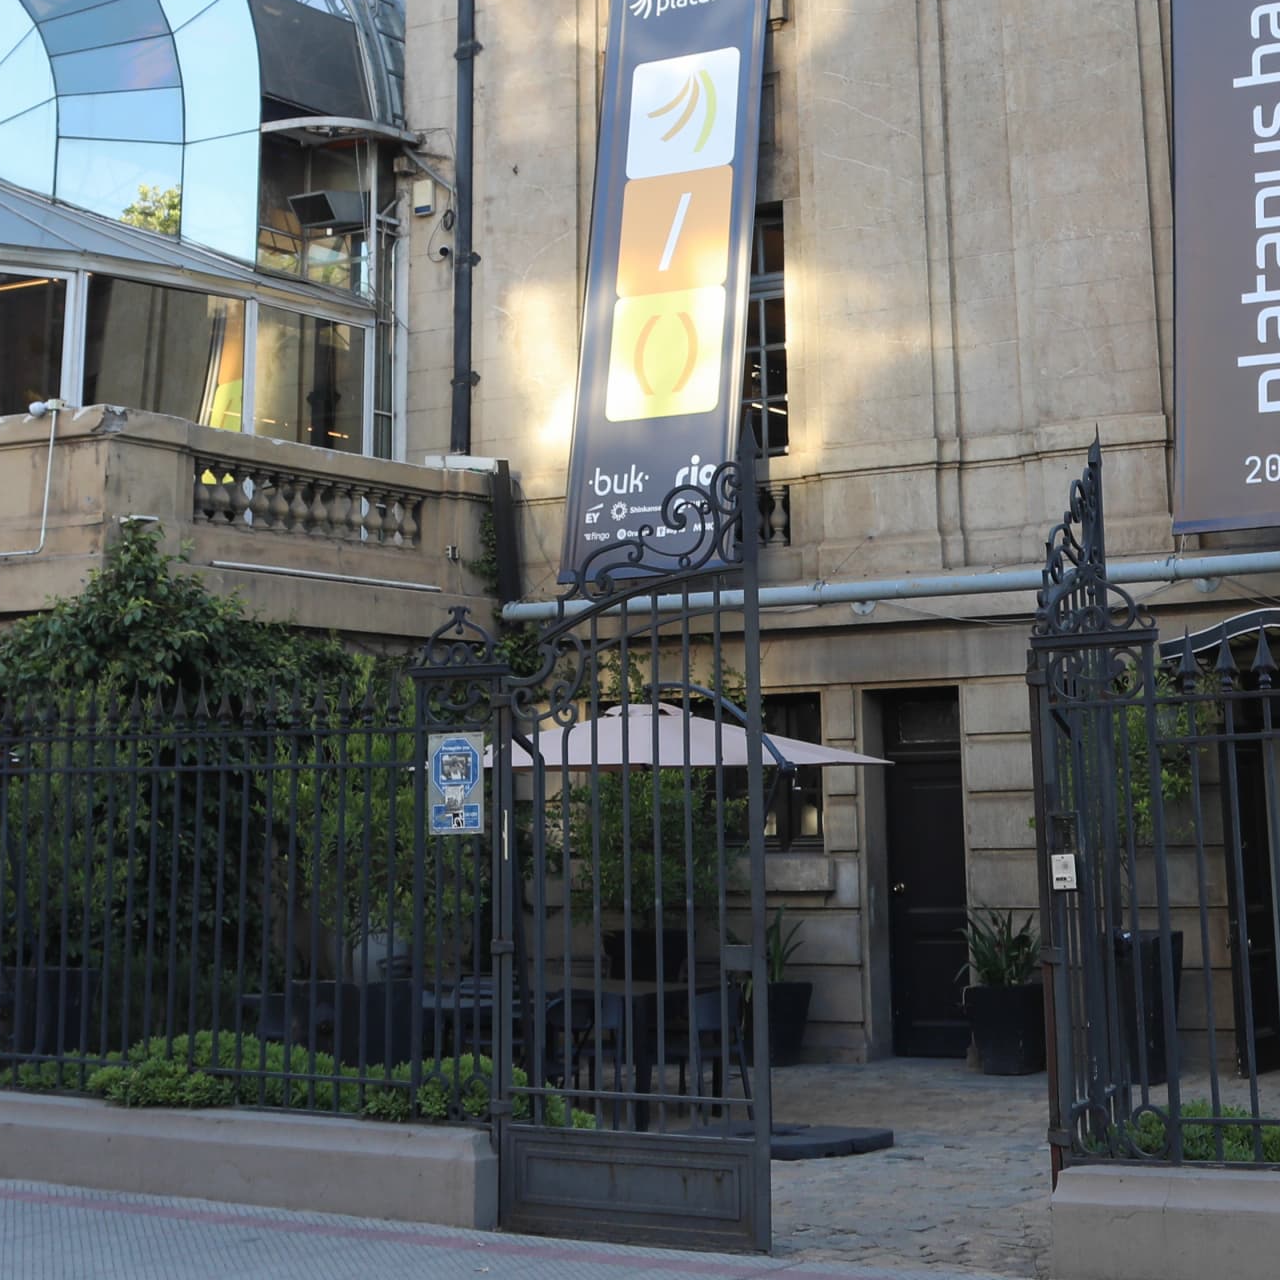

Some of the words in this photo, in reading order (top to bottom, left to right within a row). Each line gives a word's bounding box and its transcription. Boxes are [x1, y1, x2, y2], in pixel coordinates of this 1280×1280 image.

[593, 463, 645, 497] buk
[584, 511, 601, 524] EY
[629, 505, 662, 514] Shinkanse
